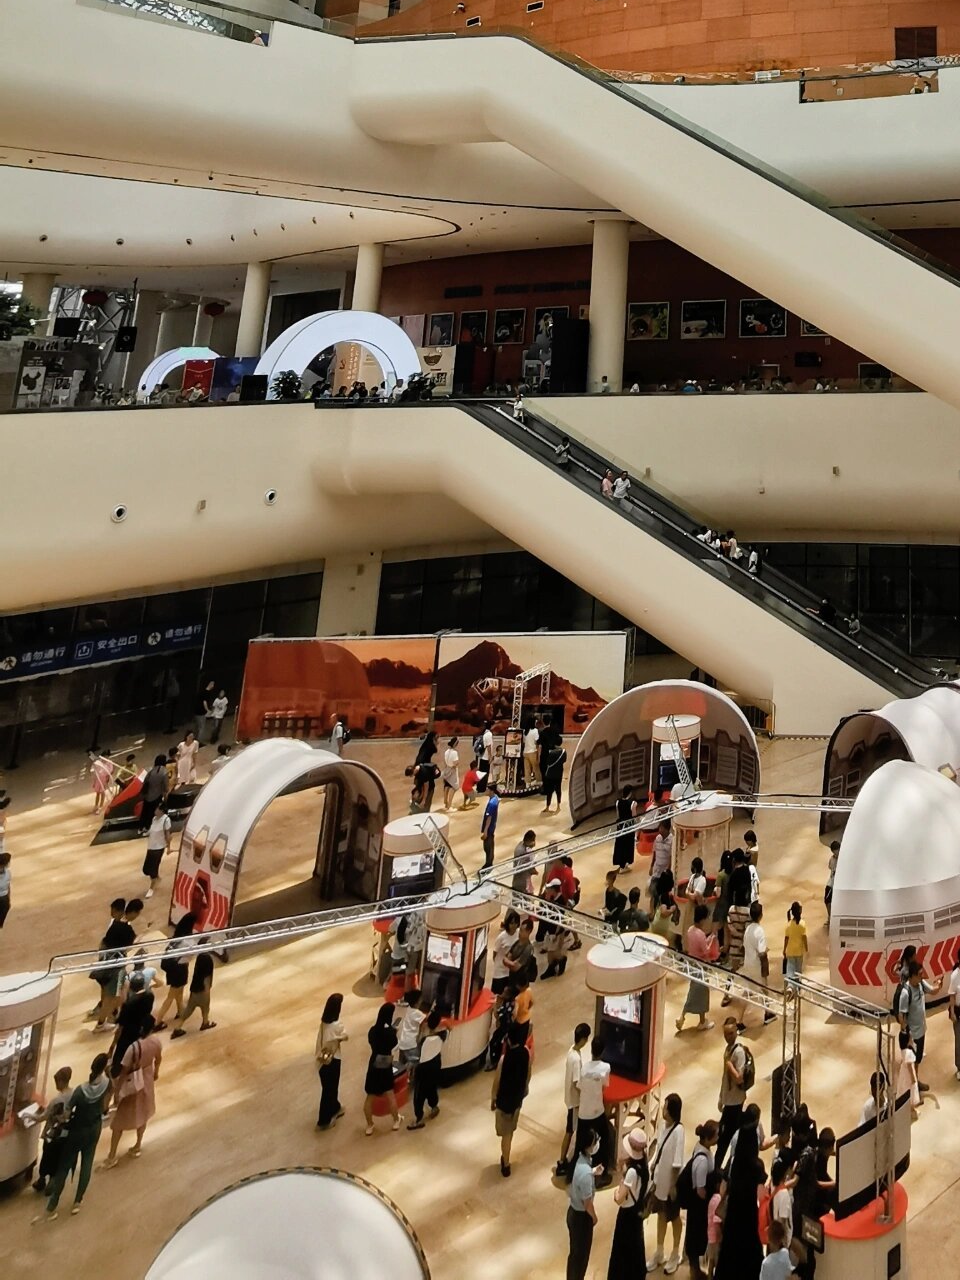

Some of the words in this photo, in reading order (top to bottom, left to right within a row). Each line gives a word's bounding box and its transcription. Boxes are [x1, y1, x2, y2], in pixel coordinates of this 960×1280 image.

[97, 635, 138, 650] 安全出口
[21, 646, 67, 663] 请勿通行
